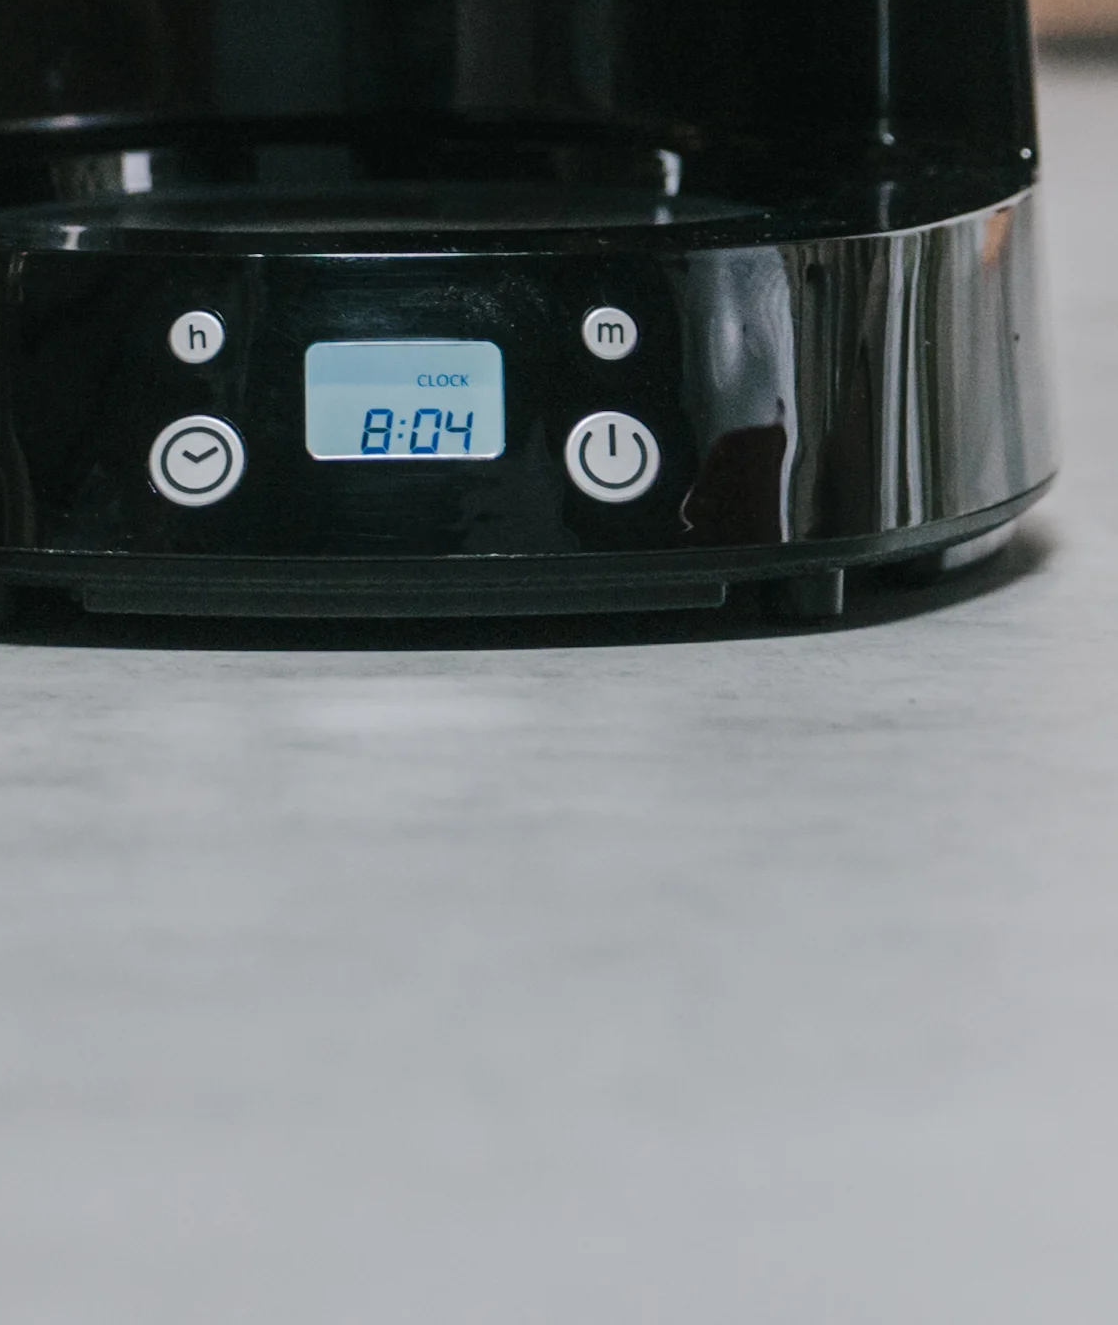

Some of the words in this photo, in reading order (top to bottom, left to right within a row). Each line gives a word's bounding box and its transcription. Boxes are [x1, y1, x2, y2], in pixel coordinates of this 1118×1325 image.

[188, 324, 207, 350] h
[596, 321, 625, 345] m
[417, 373, 470, 388] CLOCK
[360, 407, 474, 455] 8:04
